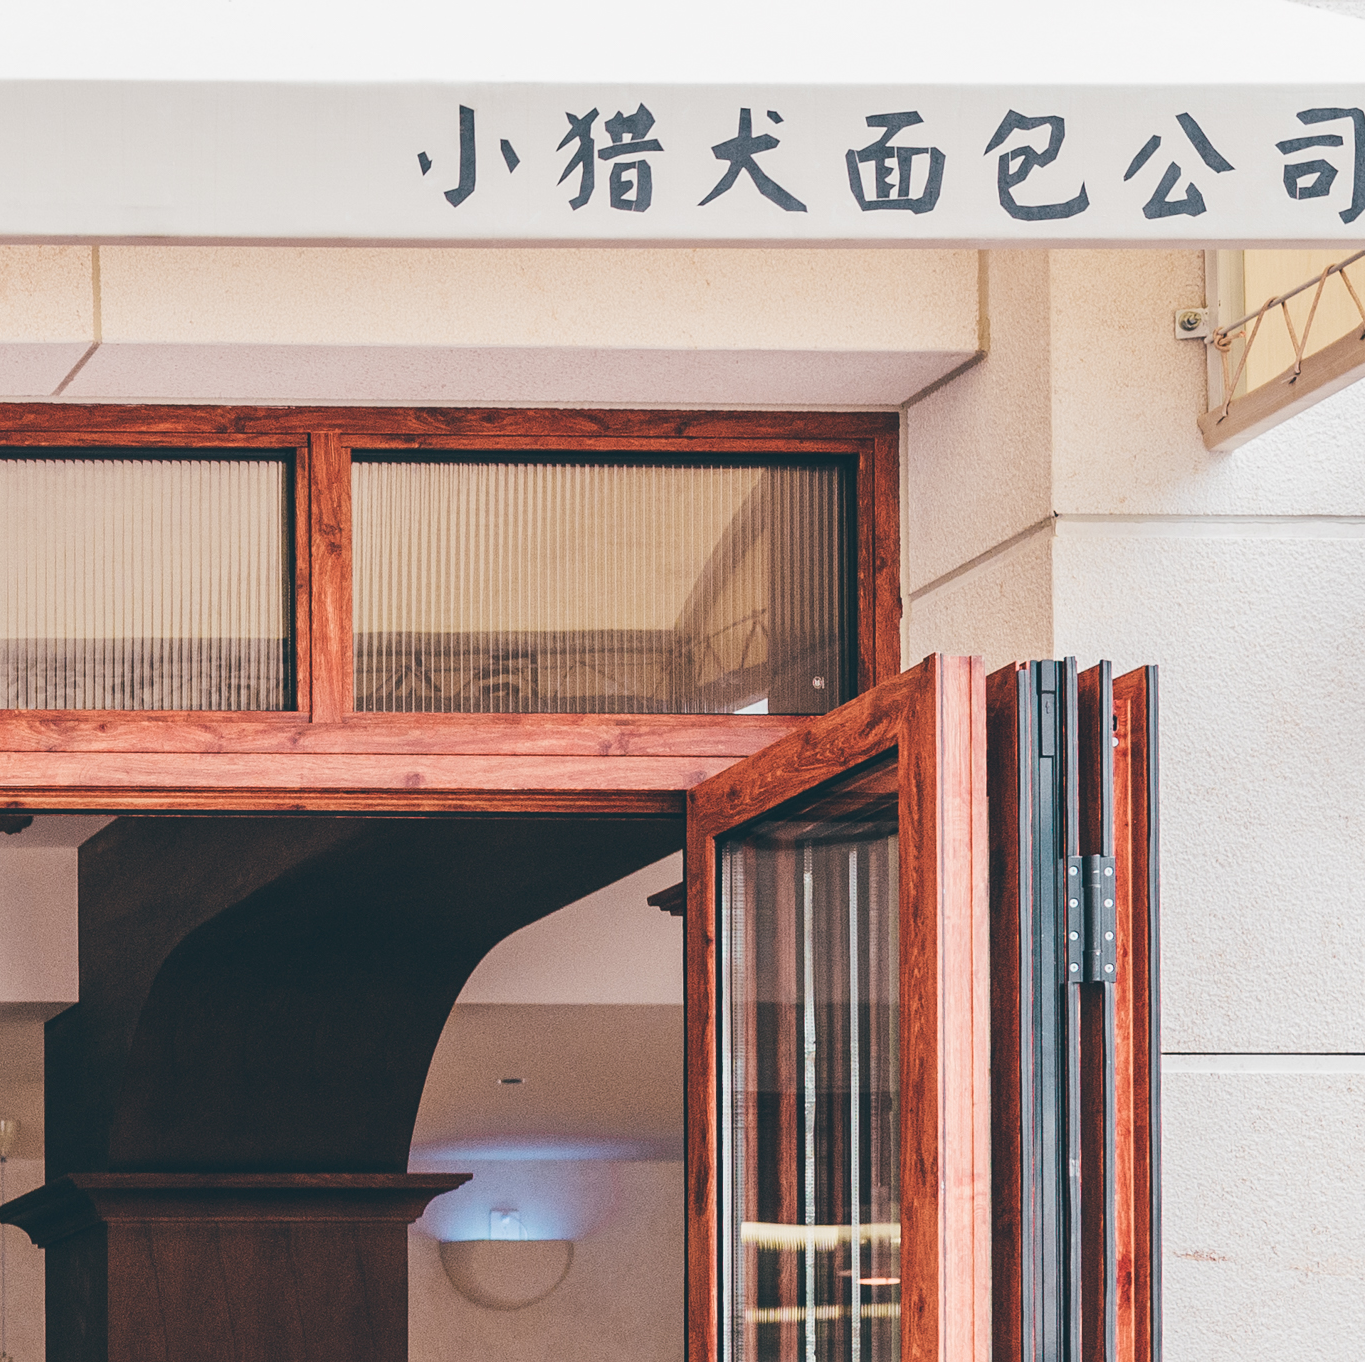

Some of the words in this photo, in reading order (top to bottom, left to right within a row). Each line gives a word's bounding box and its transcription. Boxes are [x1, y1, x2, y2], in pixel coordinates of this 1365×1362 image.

[416, 103, 1365, 224] 小猎犬面包公司
